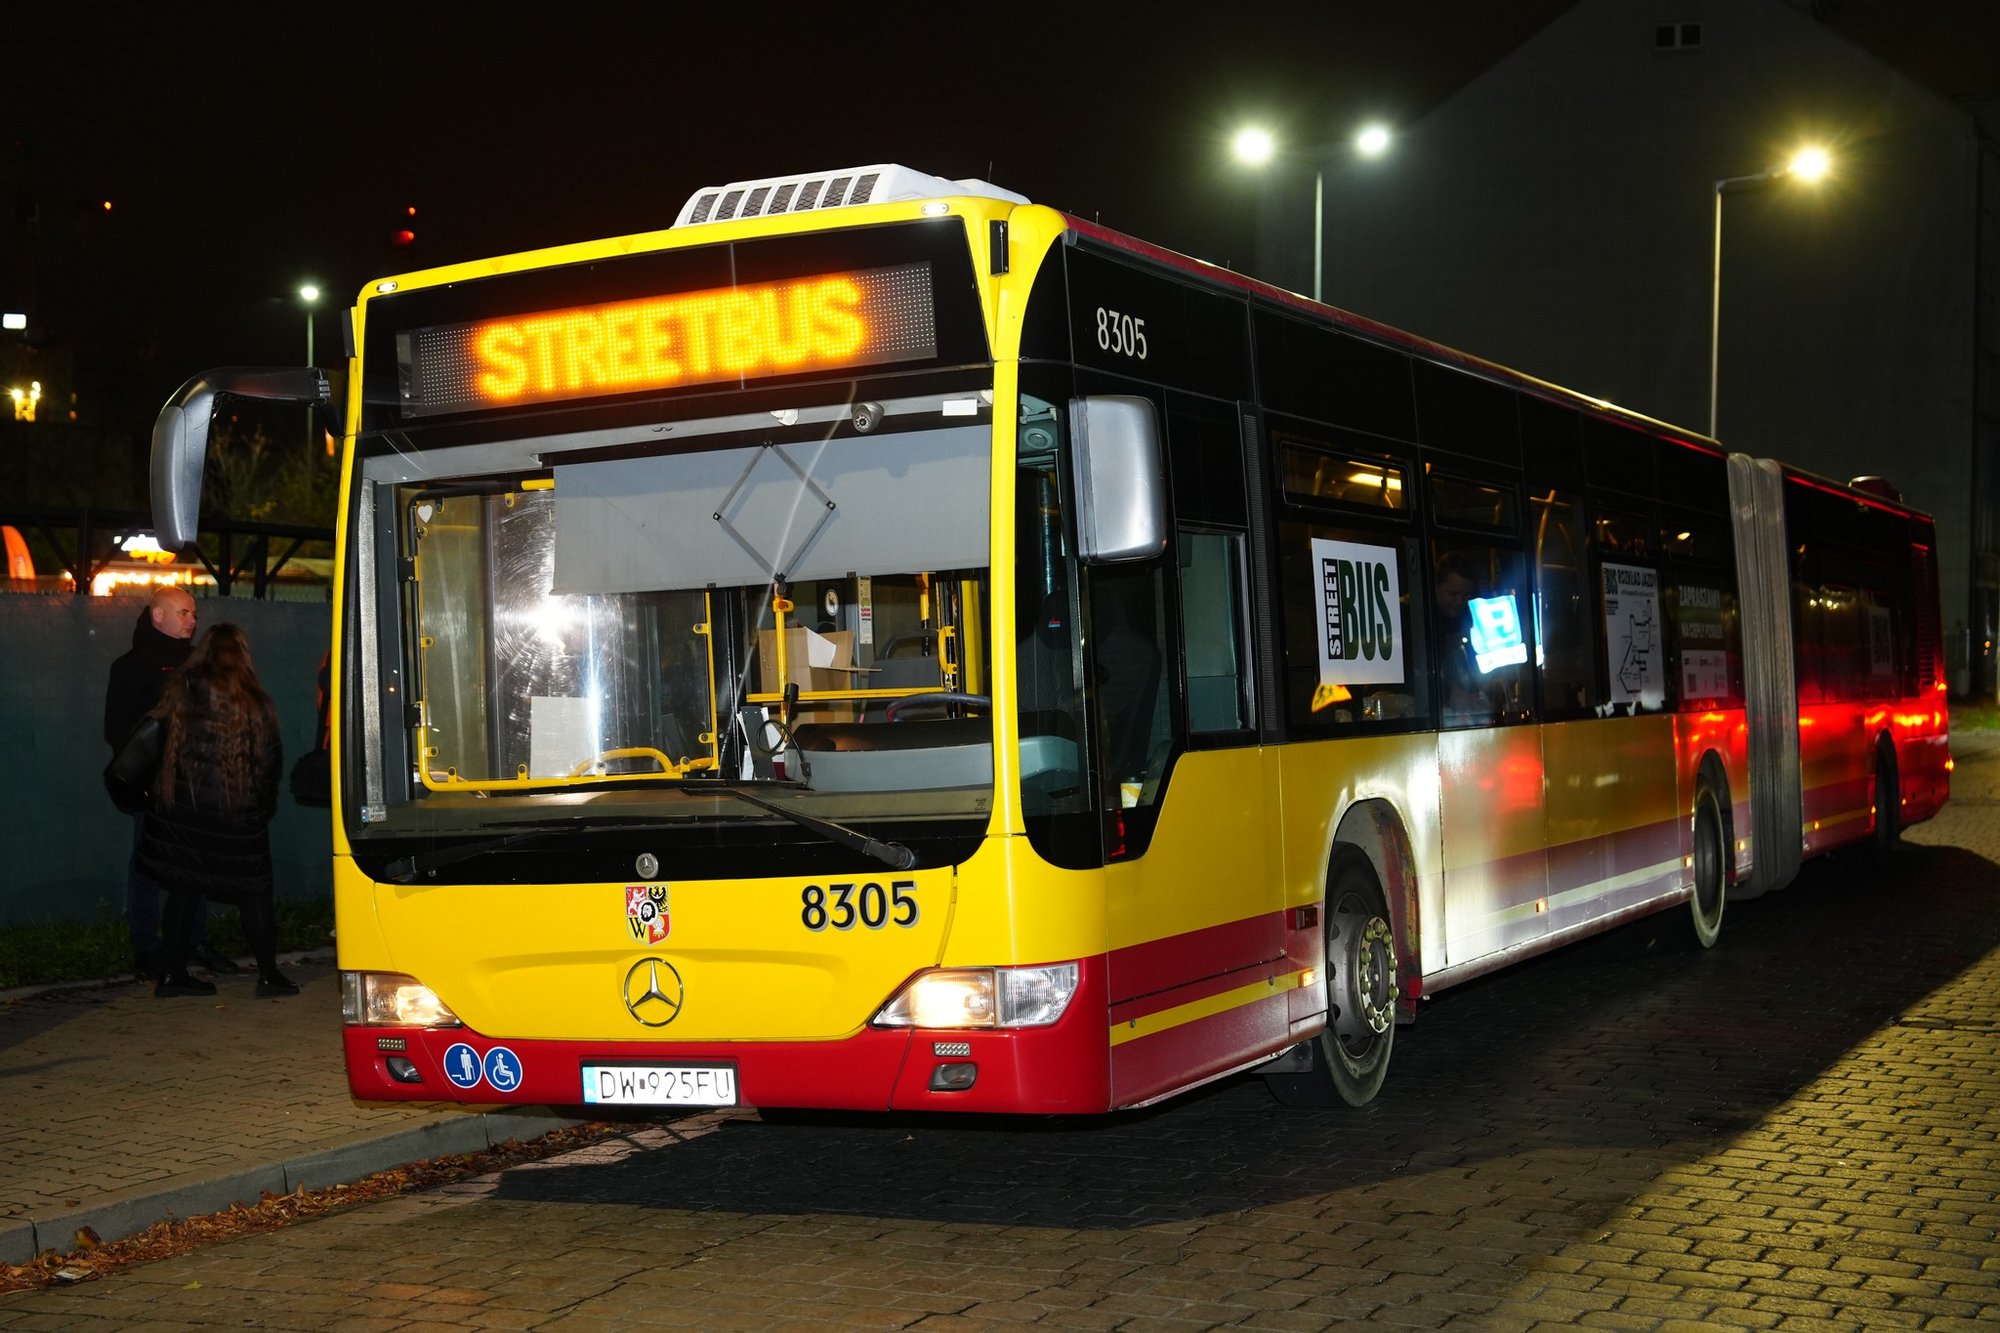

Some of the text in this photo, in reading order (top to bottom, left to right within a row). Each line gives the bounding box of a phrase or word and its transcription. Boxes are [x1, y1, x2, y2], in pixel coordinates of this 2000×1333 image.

[478, 276, 865, 399] STREETBUS
[1096, 306, 1148, 360] 8305
[1323, 560, 1342, 657] STREET
[1339, 559, 1393, 661] BUS
[801, 880, 920, 932] 8305
[600, 1071, 730, 1099] DW 925FU
